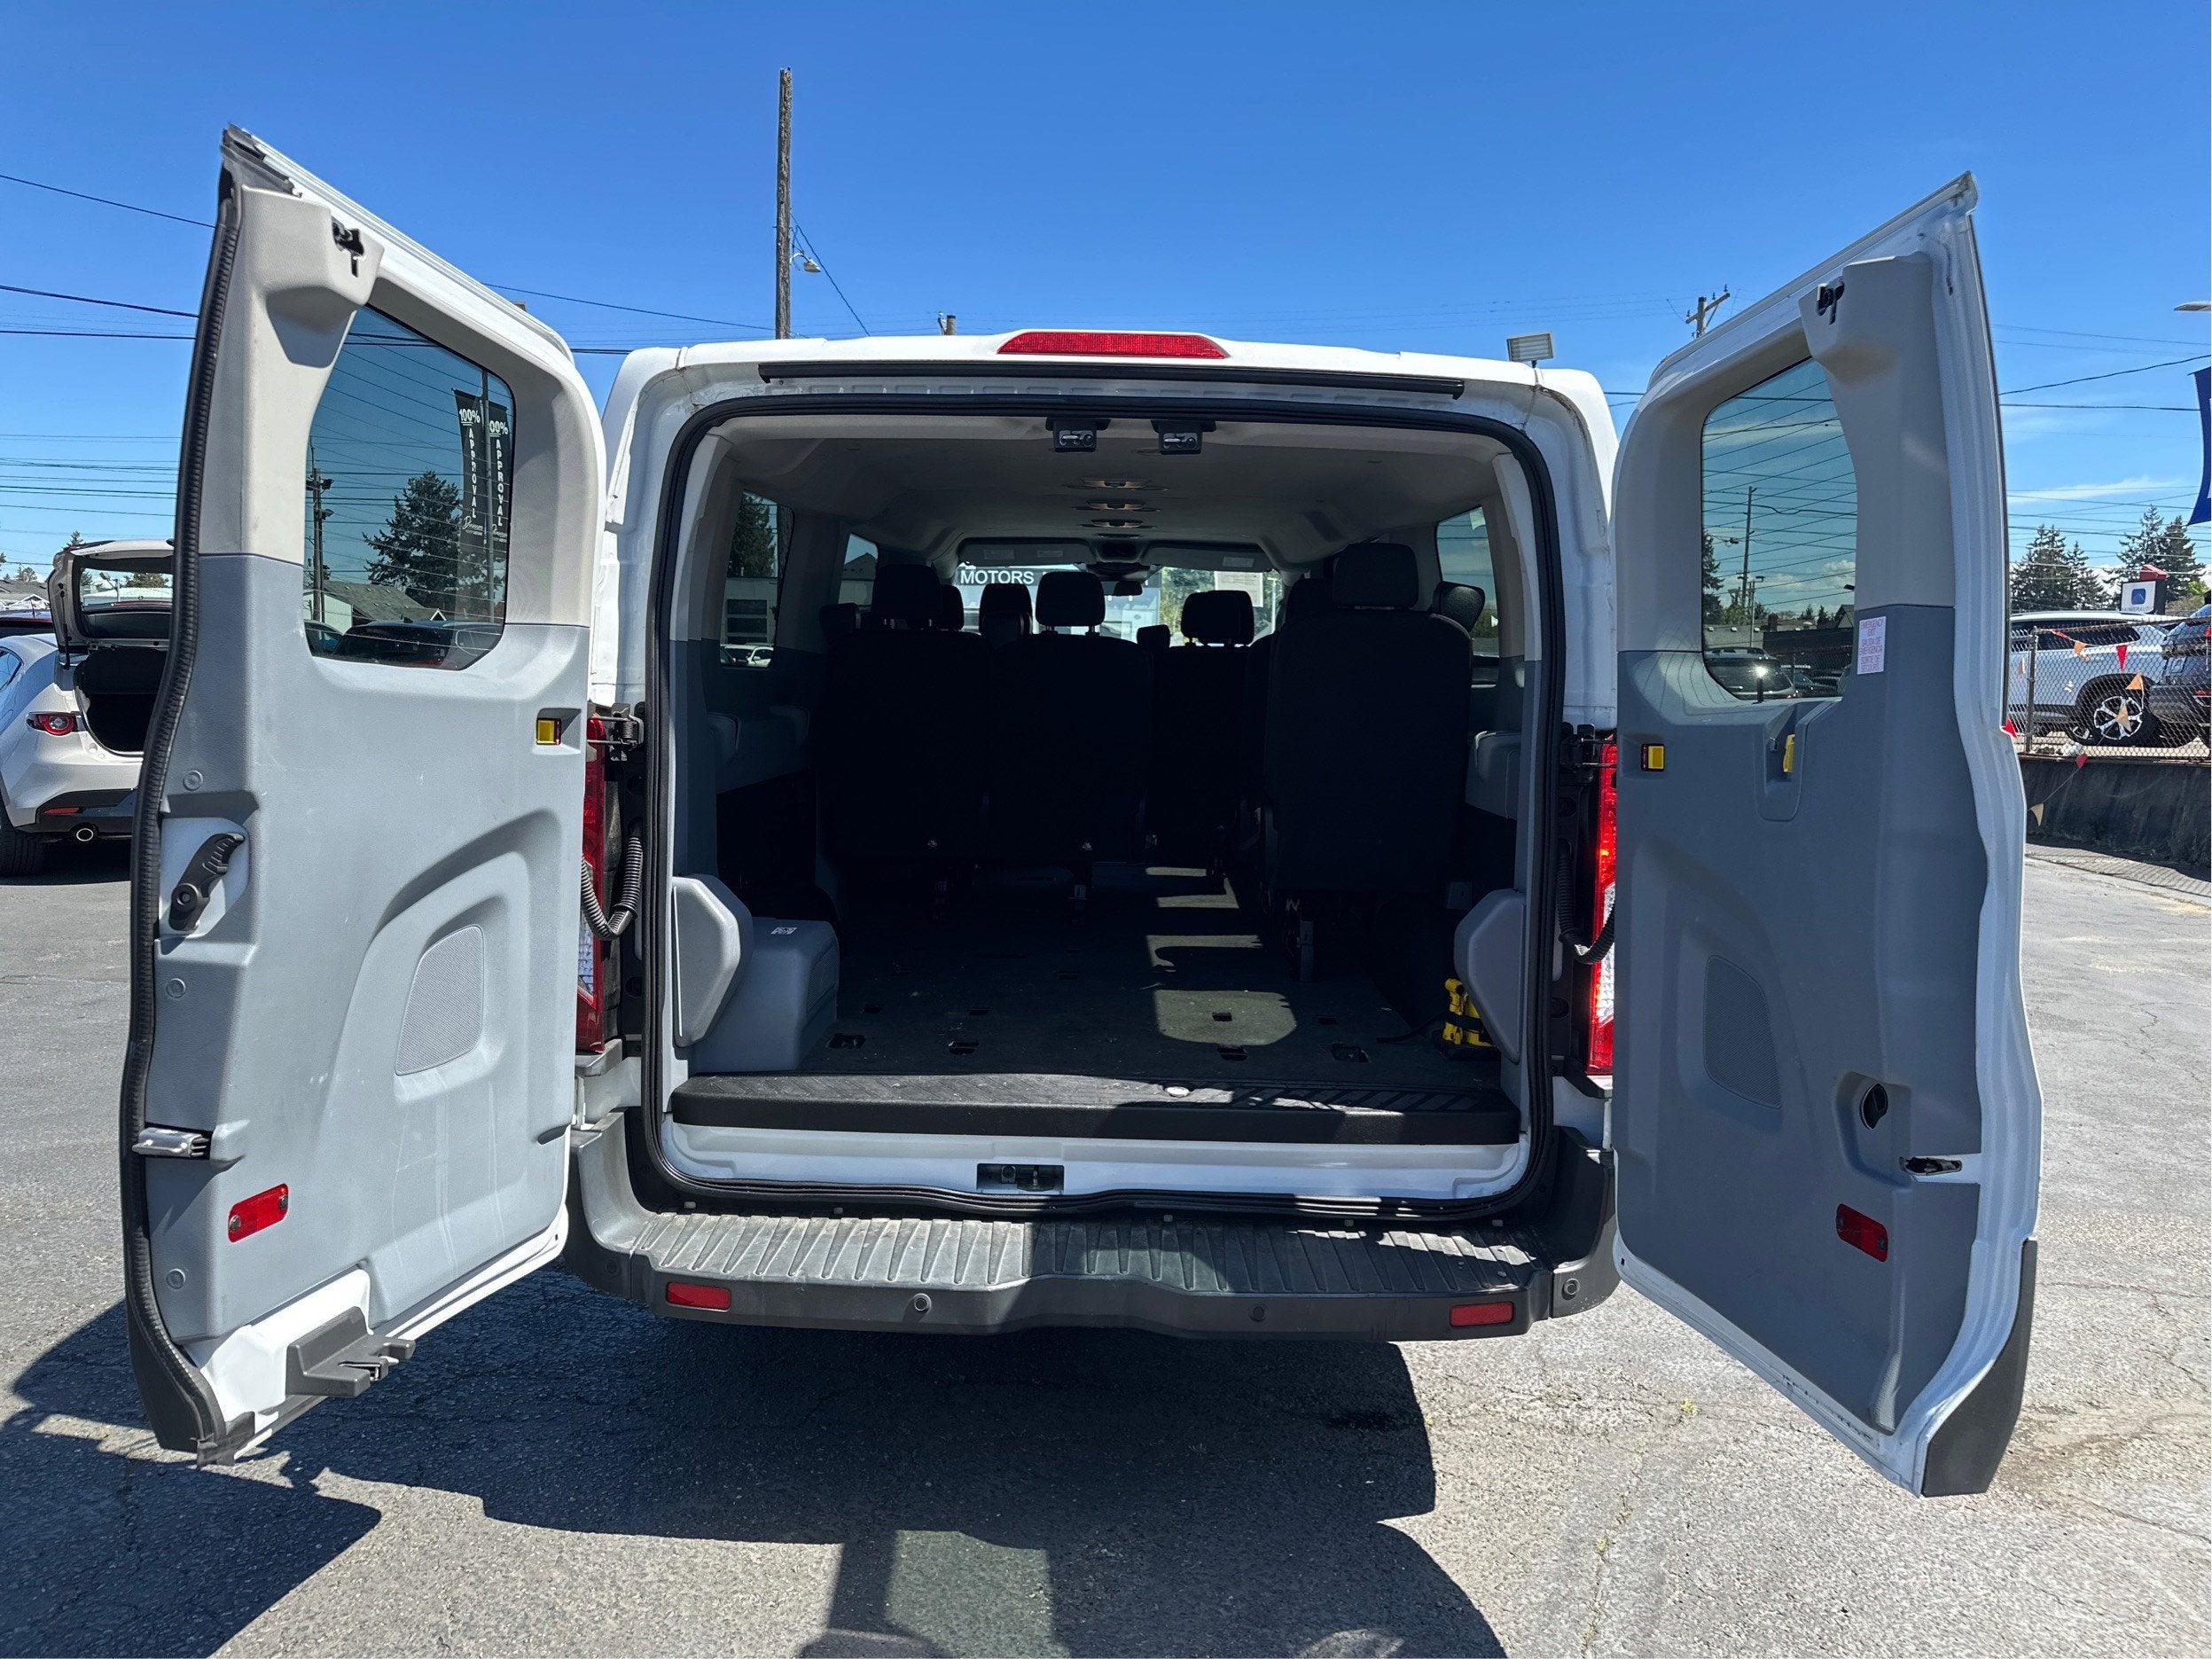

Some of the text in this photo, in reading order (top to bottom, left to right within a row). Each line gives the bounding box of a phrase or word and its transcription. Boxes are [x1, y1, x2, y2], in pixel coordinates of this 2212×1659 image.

[459, 409, 481, 423] 100%
[489, 419, 509, 434] 00%
[468, 427, 477, 518] APPROVAL
[960, 569, 1035, 584] MOTORS
